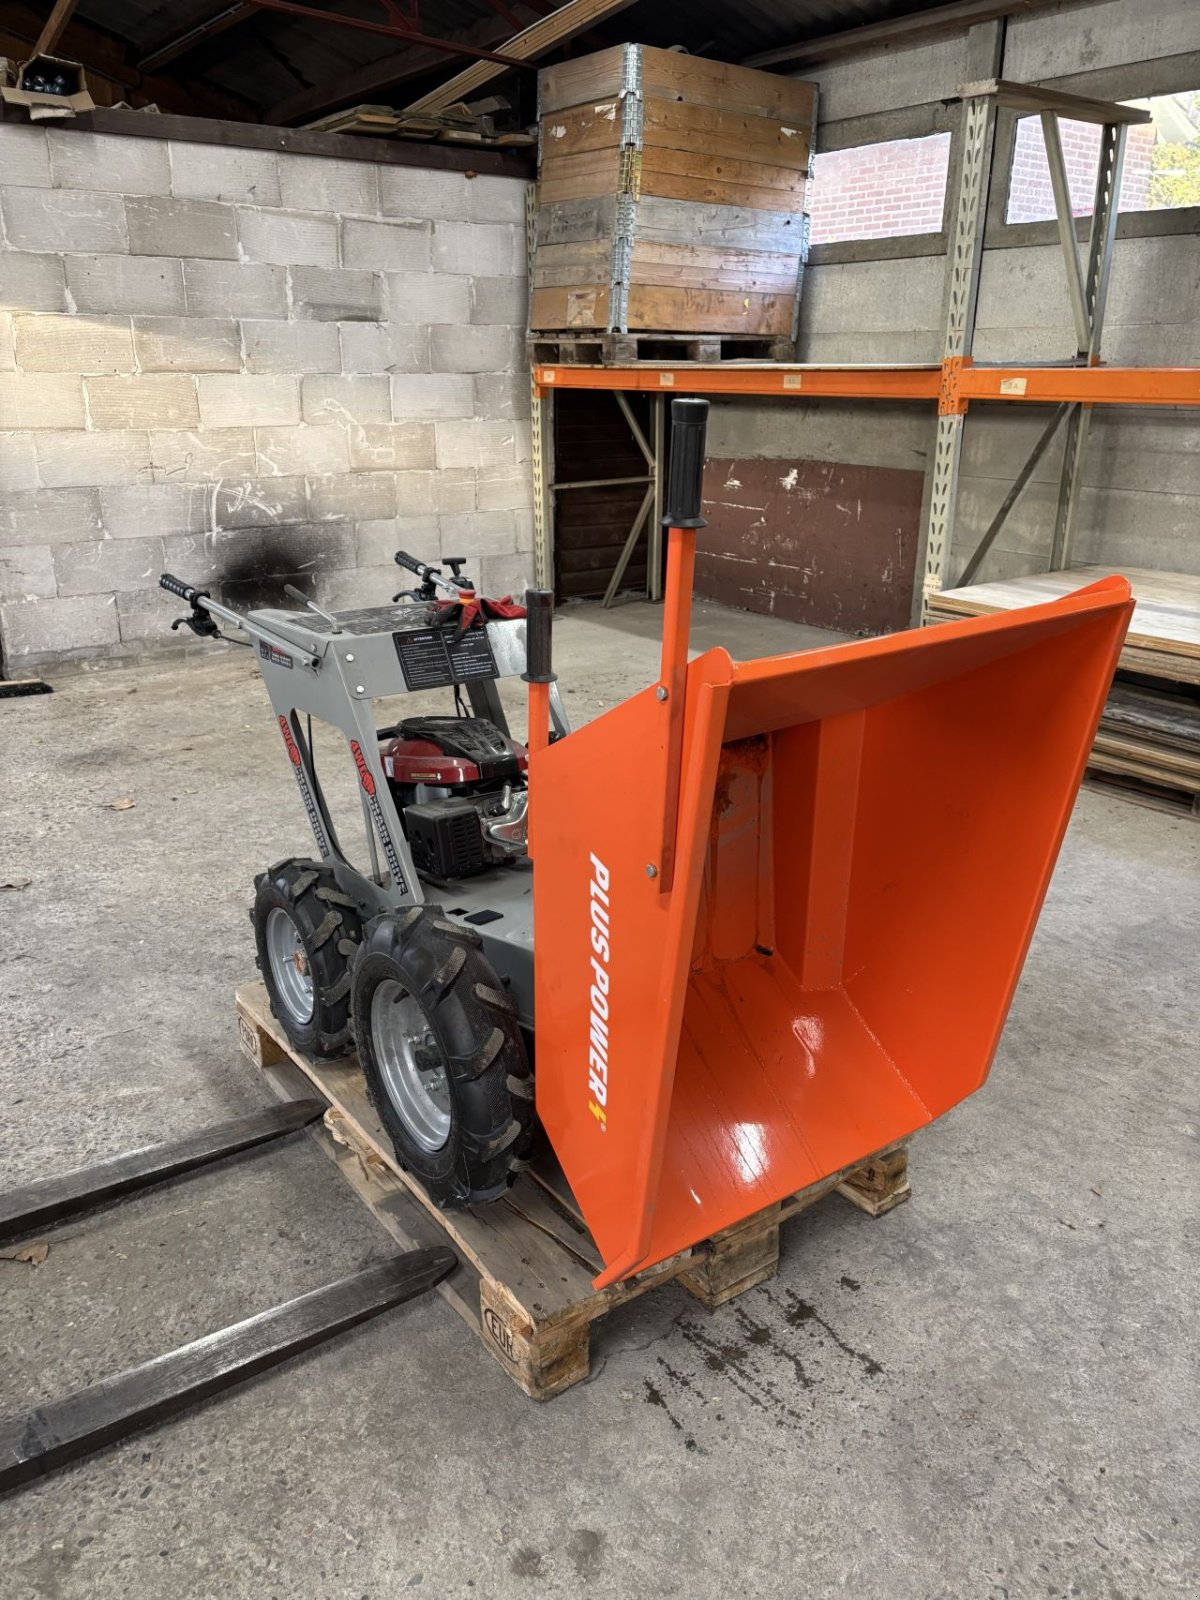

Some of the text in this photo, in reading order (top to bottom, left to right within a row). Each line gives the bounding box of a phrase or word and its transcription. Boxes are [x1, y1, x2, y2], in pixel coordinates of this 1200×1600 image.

[588, 852, 610, 1107] PLUS POWER
[491, 1316, 514, 1358] EUR
